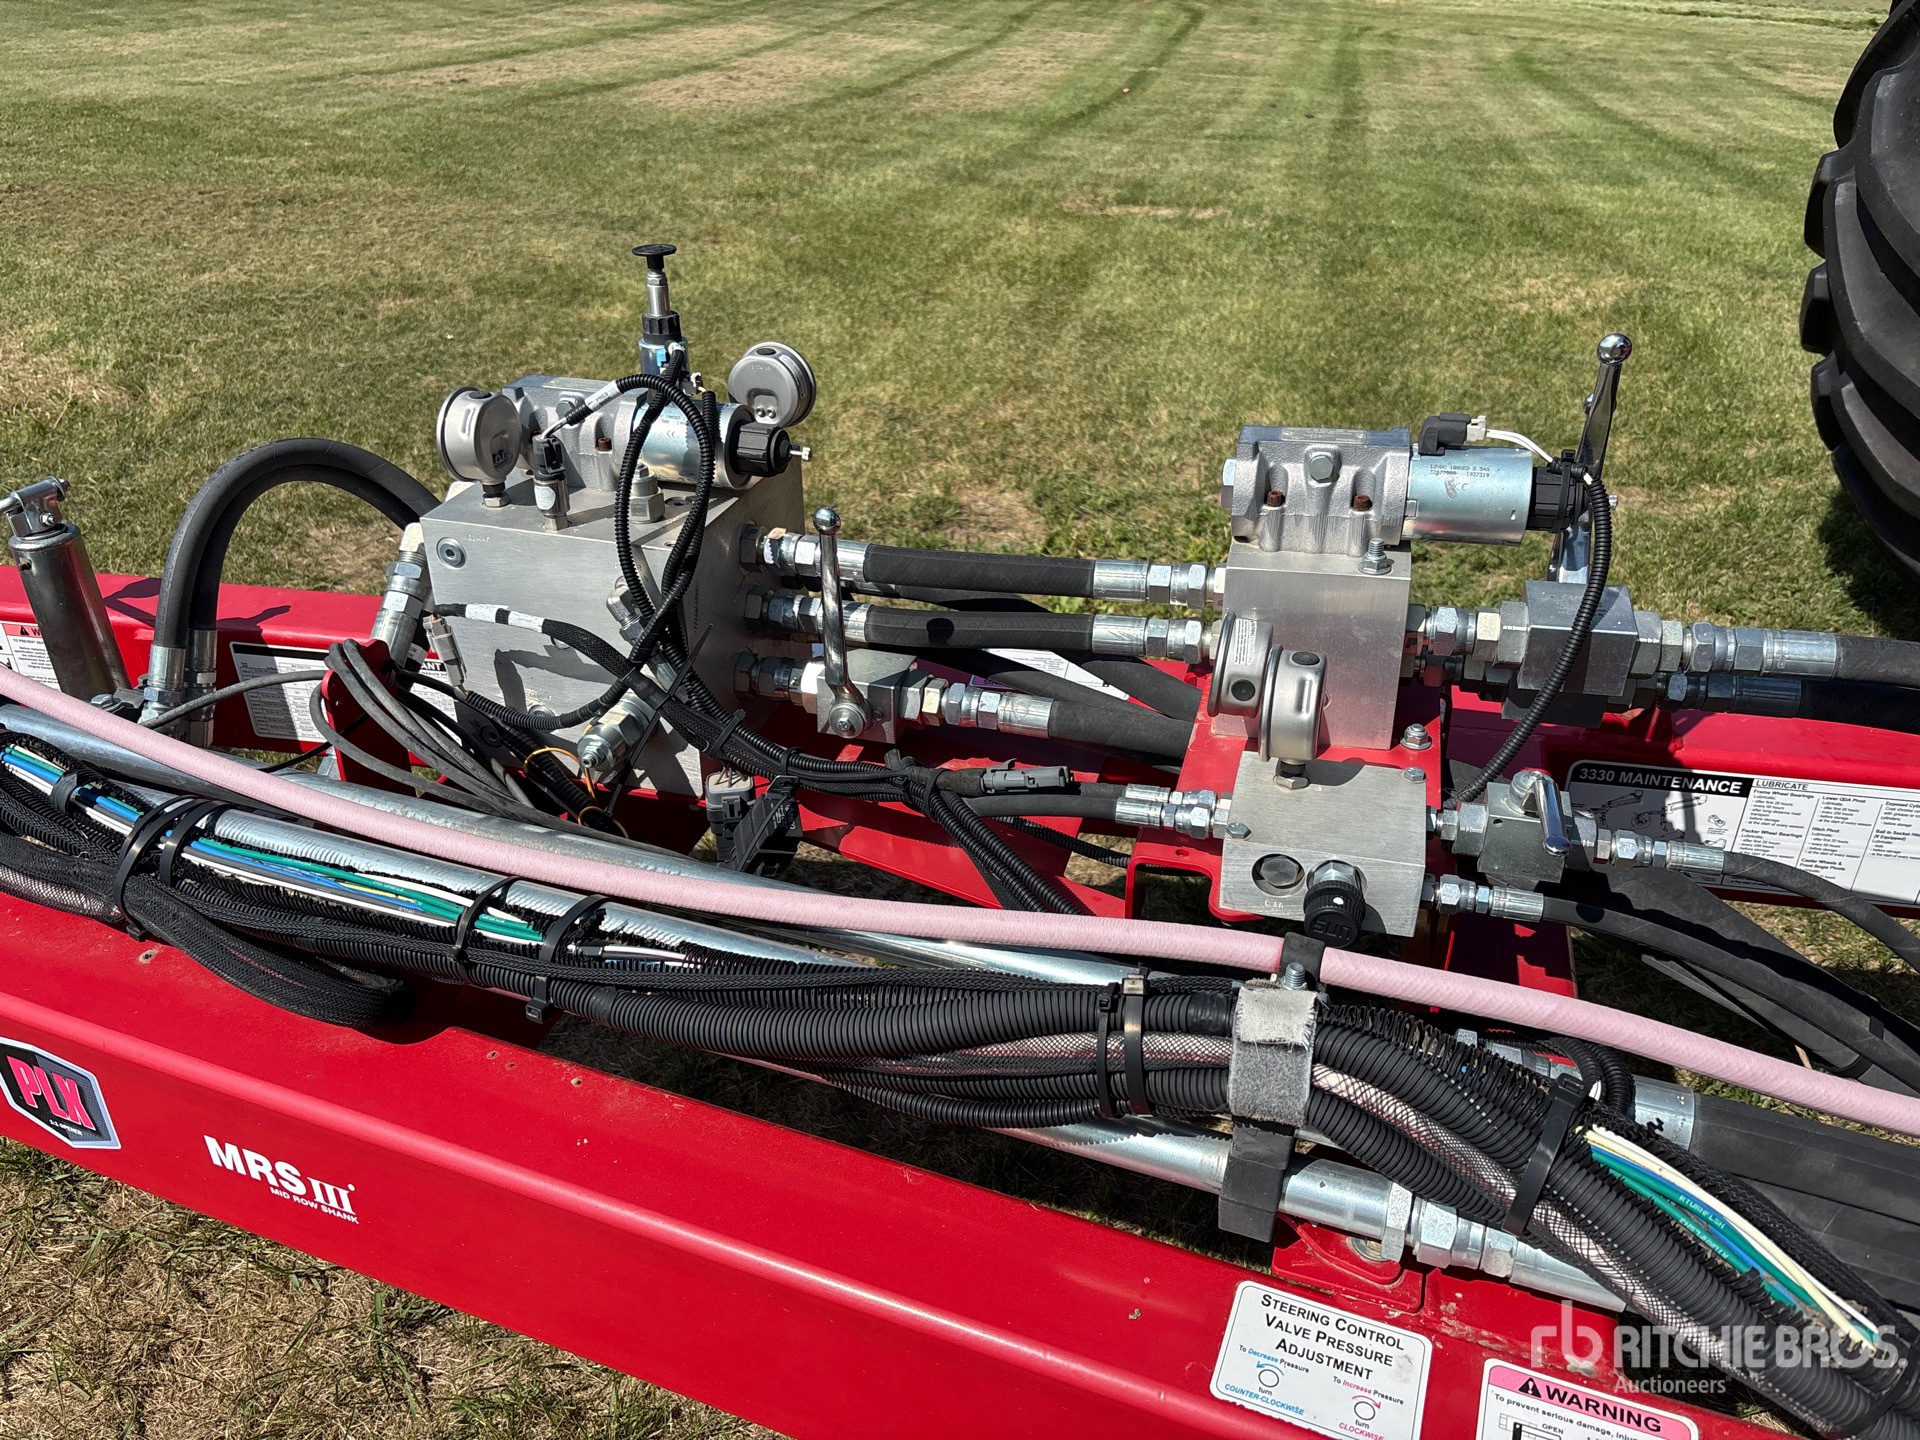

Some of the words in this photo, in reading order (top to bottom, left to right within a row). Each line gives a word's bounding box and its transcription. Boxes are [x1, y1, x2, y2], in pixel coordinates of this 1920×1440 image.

[1579, 768, 1615, 781] 3330
[1619, 771, 1742, 794] MAINTENANCE
[1756, 780, 1808, 790] LUBRICATE
[6, 1055, 96, 1131] PLX
[204, 1135, 307, 1195] MRS
[307, 1176, 356, 1215] III
[270, 1187, 291, 1200] MID
[293, 1195, 318, 1210] ROW
[321, 1204, 359, 1225] SHANK
[1261, 1294, 1330, 1326] STEERING
[1335, 1318, 1404, 1351] CONTROL
[1265, 1313, 1312, 1340] VALVE
[1316, 1330, 1393, 1367] PRESSURE
[1248, 1348, 1279, 1363] Decrease
[1280, 1359, 1310, 1373] Pressure
[1275, 1338, 1373, 1380] ADJUSTMENT
[1225, 1384, 1305, 1415] COUNTER-CLOCKWISE
[1258, 1386, 1273, 1396] turn
[1333, 1376, 1341, 1384] To
[1342, 1380, 1372, 1394] Increase
[1373, 1390, 1404, 1405] Pressure
[1355, 1419, 1370, 1429] turn
[1494, 1394, 1505, 1402] To
[1507, 1398, 1540, 1414] prevent
[1541, 1410, 1574, 1424] serious
[1576, 1419, 1614, 1438] damage,
[1545, 1385, 1662, 1433] WARNING
[1339, 1422, 1385, 1440] CLOCKWISE
[1541, 1423, 1564, 1435] OPEN
